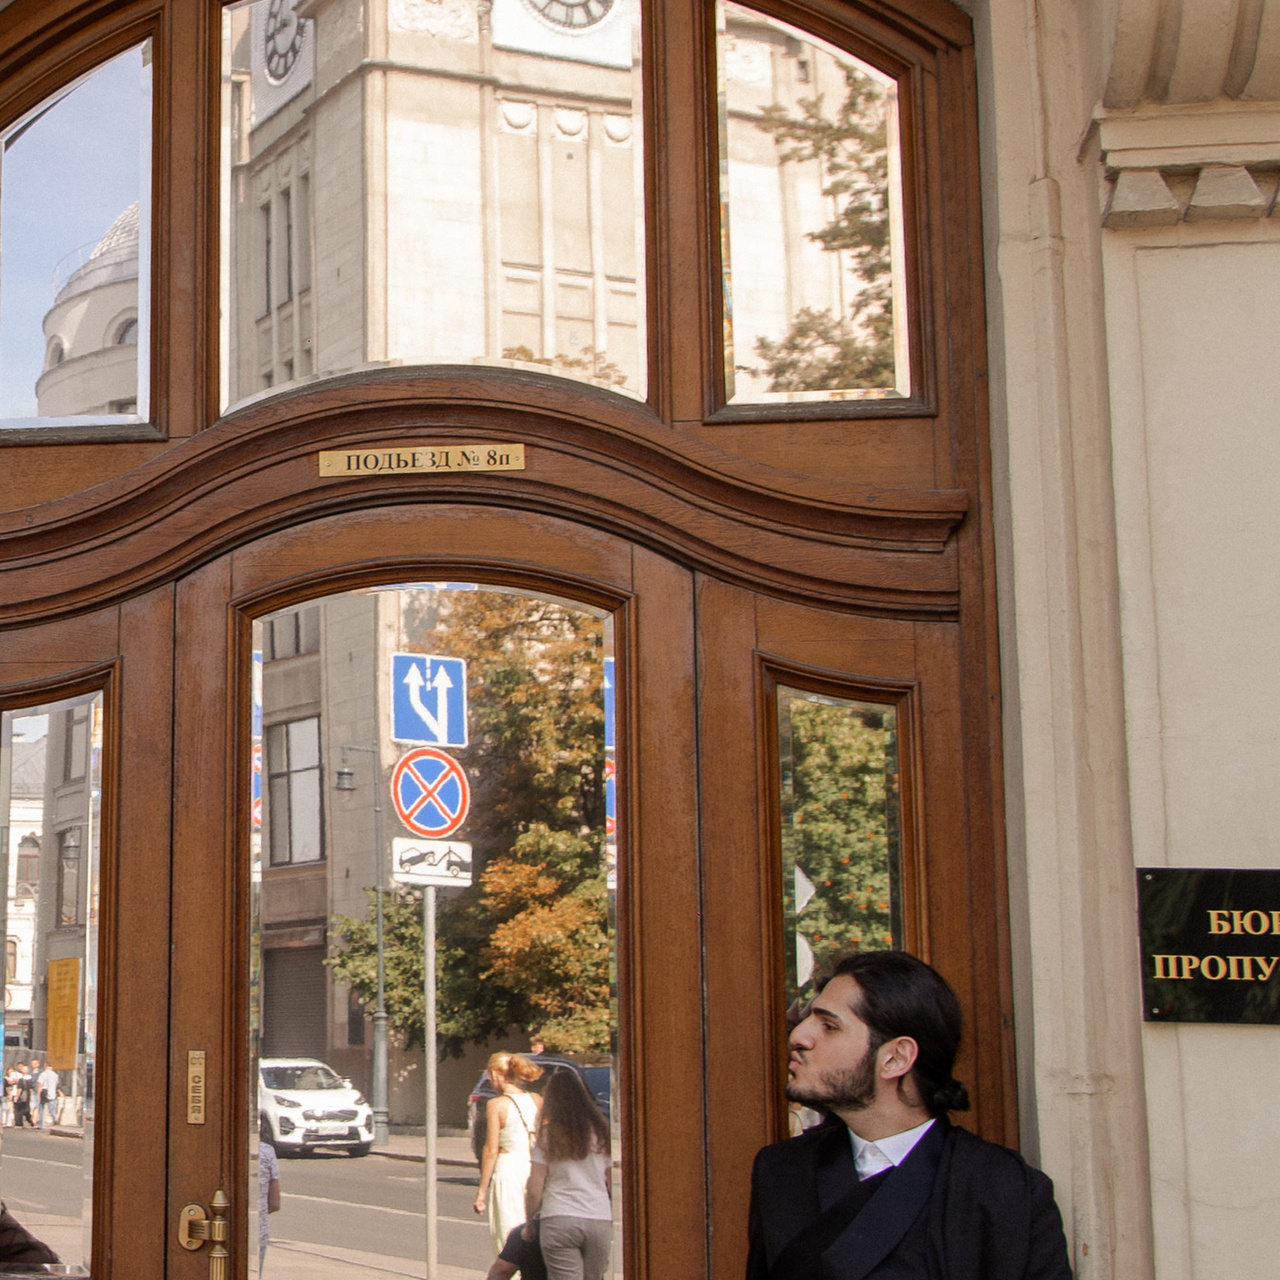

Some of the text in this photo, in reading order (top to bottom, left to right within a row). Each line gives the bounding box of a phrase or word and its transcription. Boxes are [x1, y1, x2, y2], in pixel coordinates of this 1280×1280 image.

[346, 451, 452, 472] ПОДЬЕЗД
[457, 450, 479, 467] №
[1152, 954, 1280, 981] ПРОПУ
